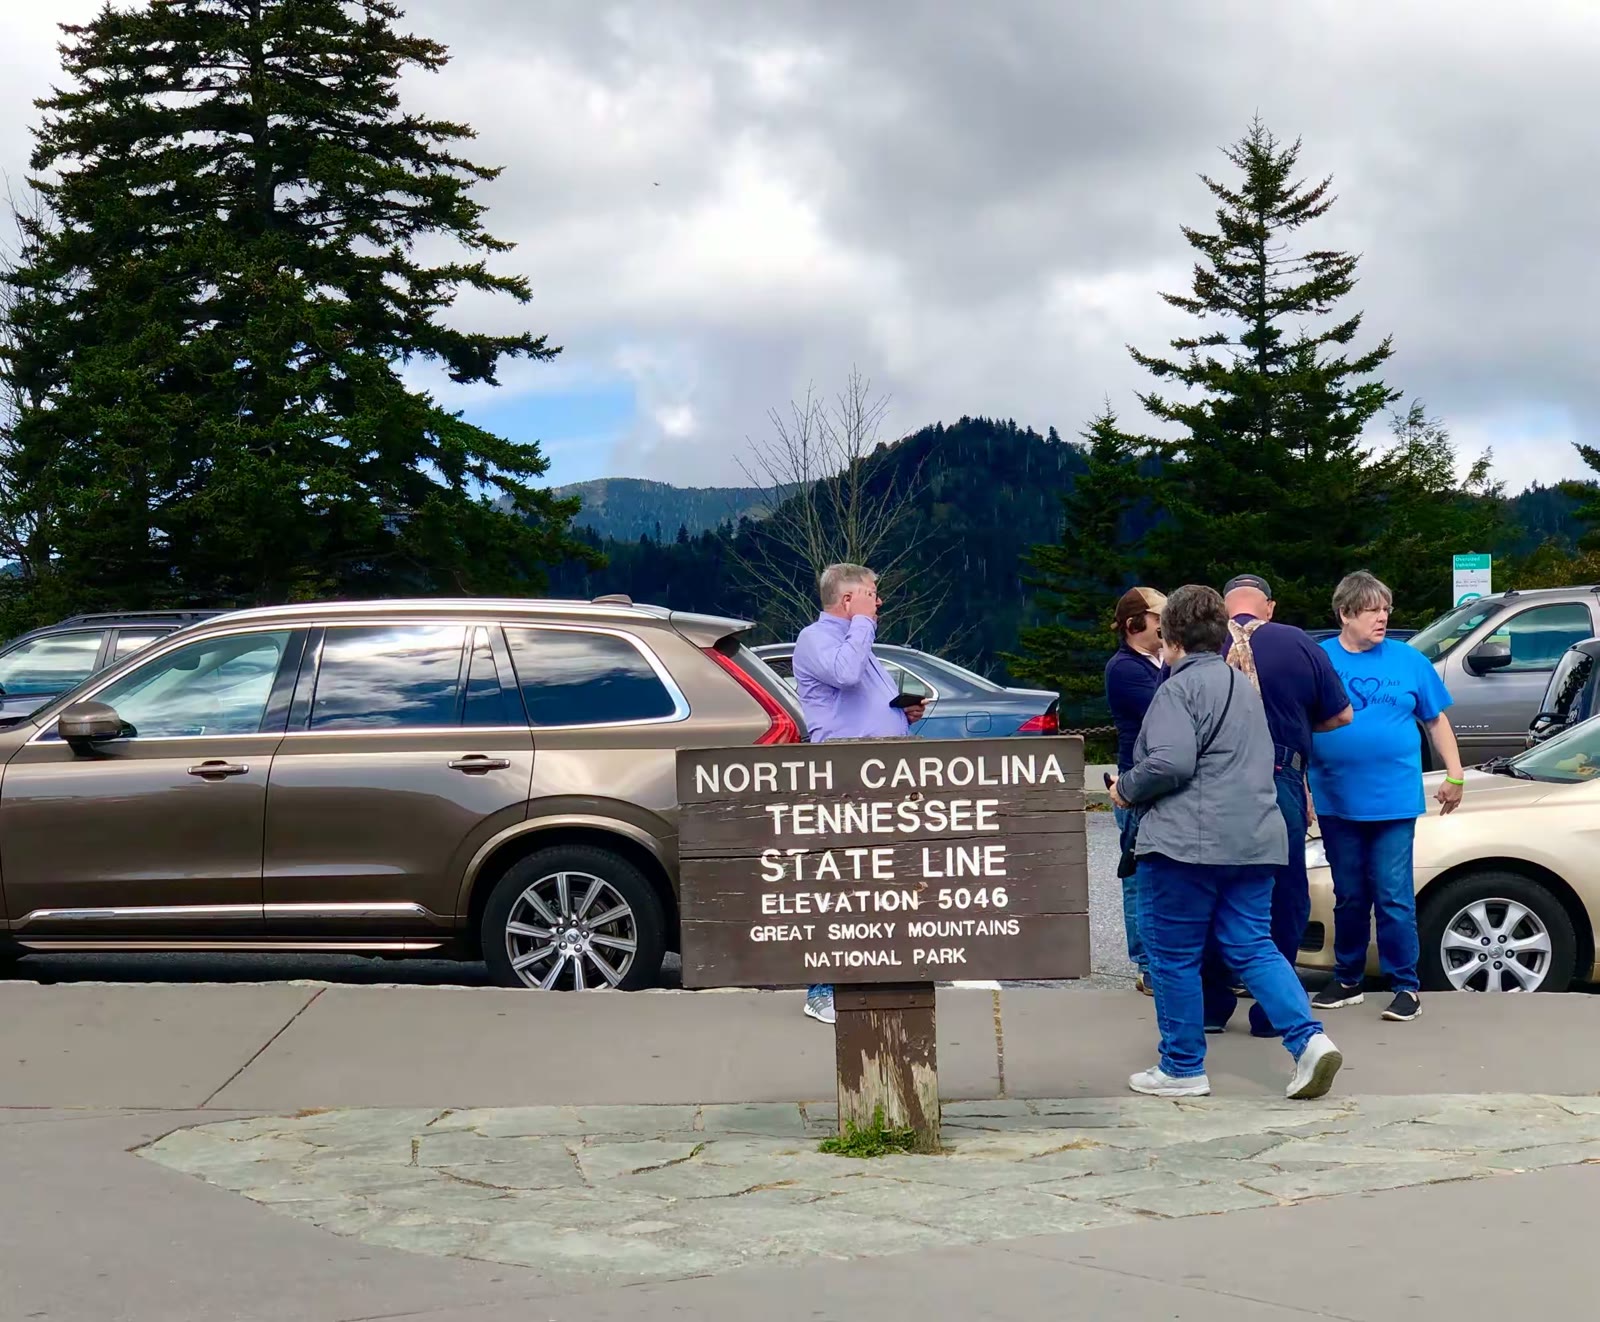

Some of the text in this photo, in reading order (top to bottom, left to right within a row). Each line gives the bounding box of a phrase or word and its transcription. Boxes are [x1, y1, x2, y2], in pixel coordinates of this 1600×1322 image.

[696, 754, 1066, 793] NORTH CAROLINA
[765, 799, 1000, 835] TENNESSEE
[760, 845, 1007, 882] STATE LINE
[761, 887, 1009, 914] ELEVATION 5046
[750, 920, 1020, 942] GREAT SMOKY MOUNTAINS
[804, 947, 967, 968] NATIONAL PARK
